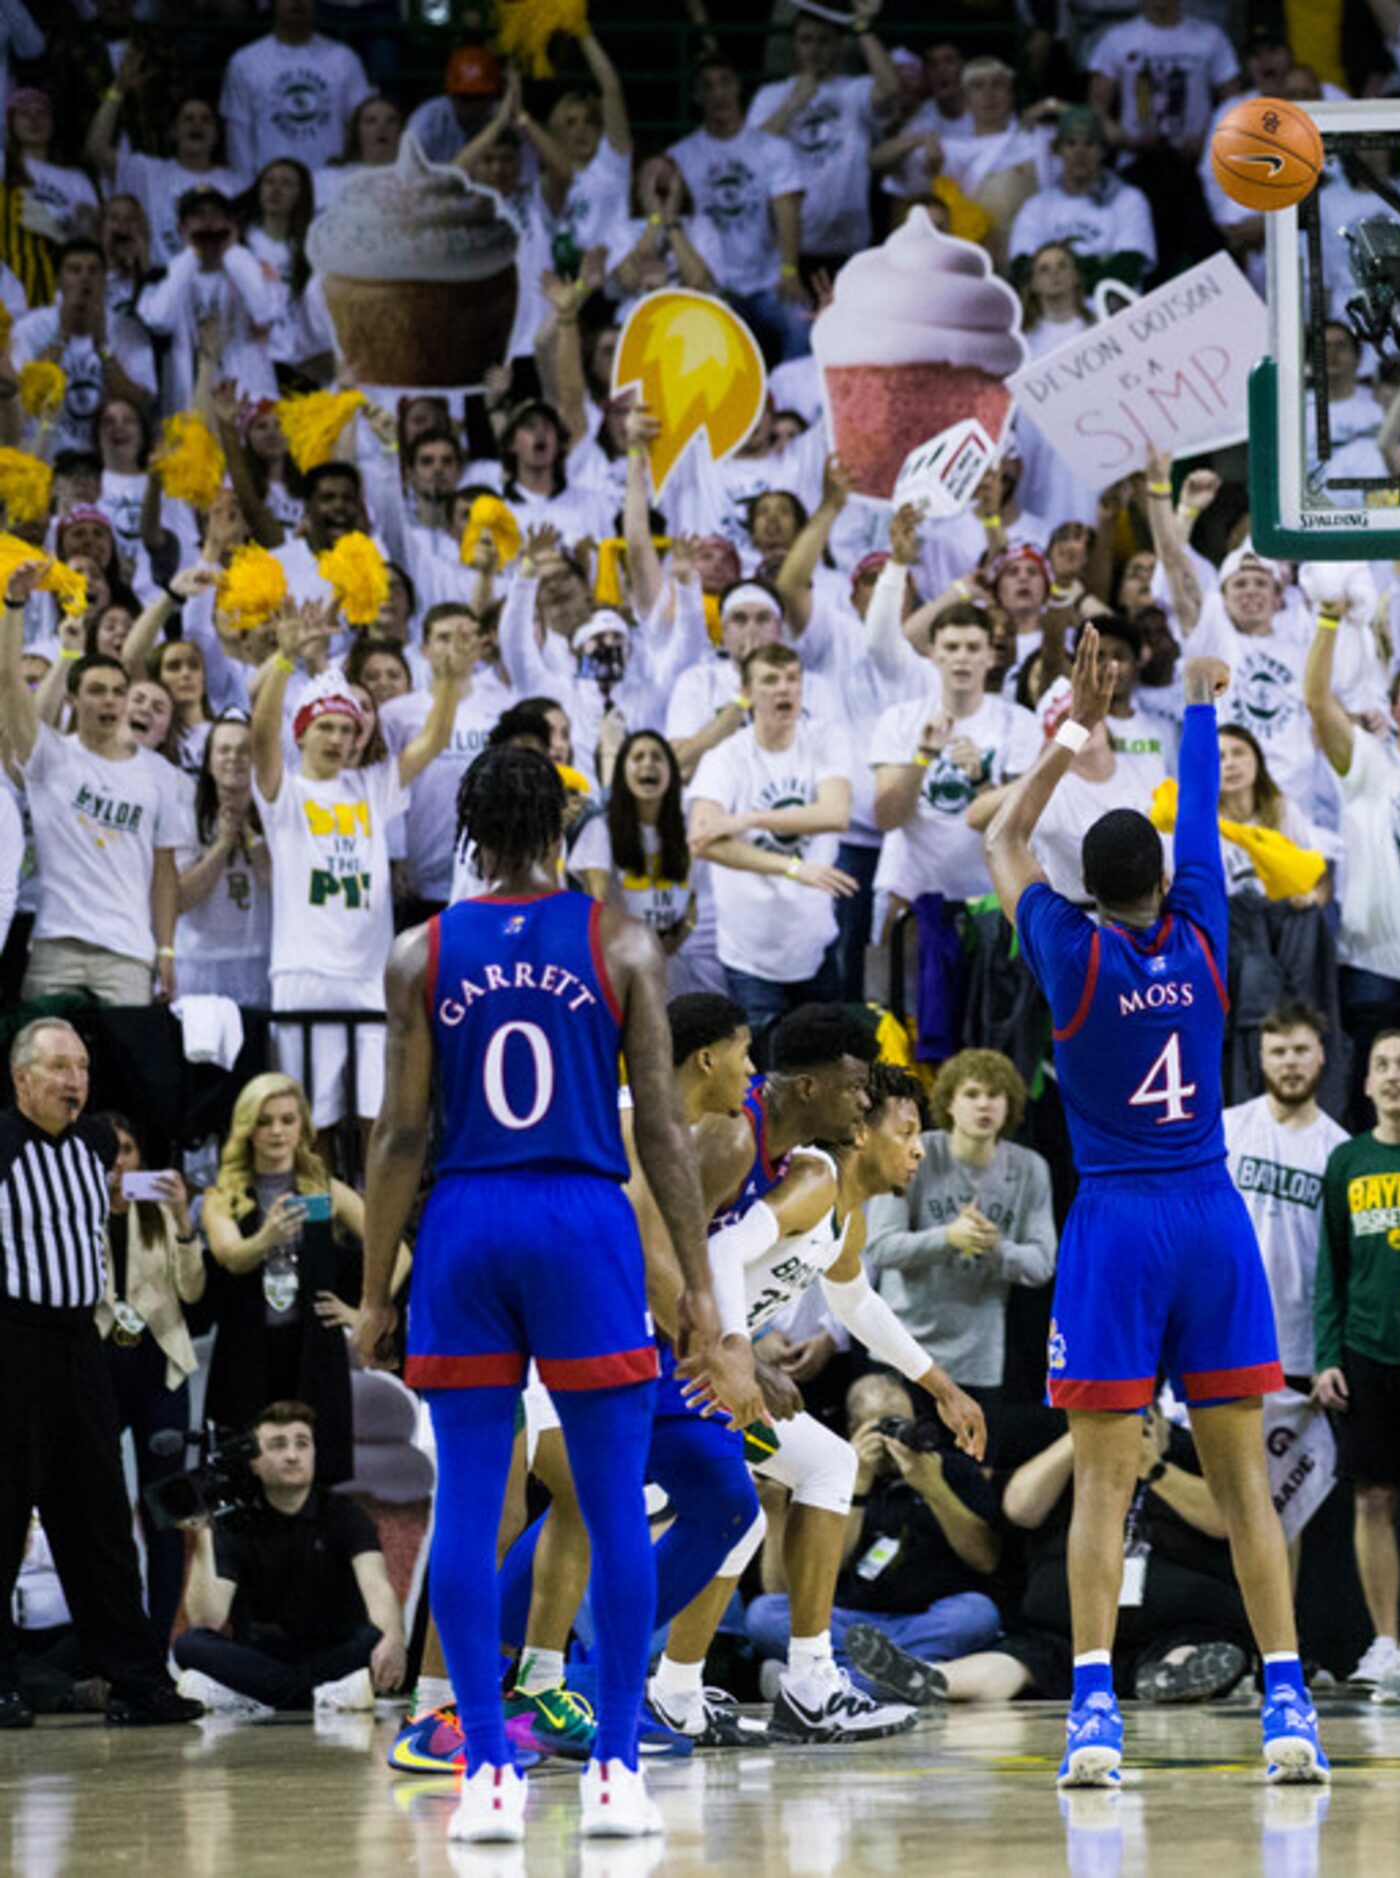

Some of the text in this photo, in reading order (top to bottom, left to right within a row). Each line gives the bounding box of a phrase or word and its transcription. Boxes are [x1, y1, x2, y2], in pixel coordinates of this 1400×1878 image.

[1024, 273, 1223, 404] DEVON DOTSON
[1074, 345, 1231, 468] SIMP
[1300, 512, 1368, 528] SPALDING
[439, 961, 596, 1027] GARRETT
[1119, 981, 1194, 1017] MOSS
[483, 1020, 554, 1130] 0
[1128, 1032, 1196, 1124] 4
[1239, 1159, 1322, 1205] BAYLOR
